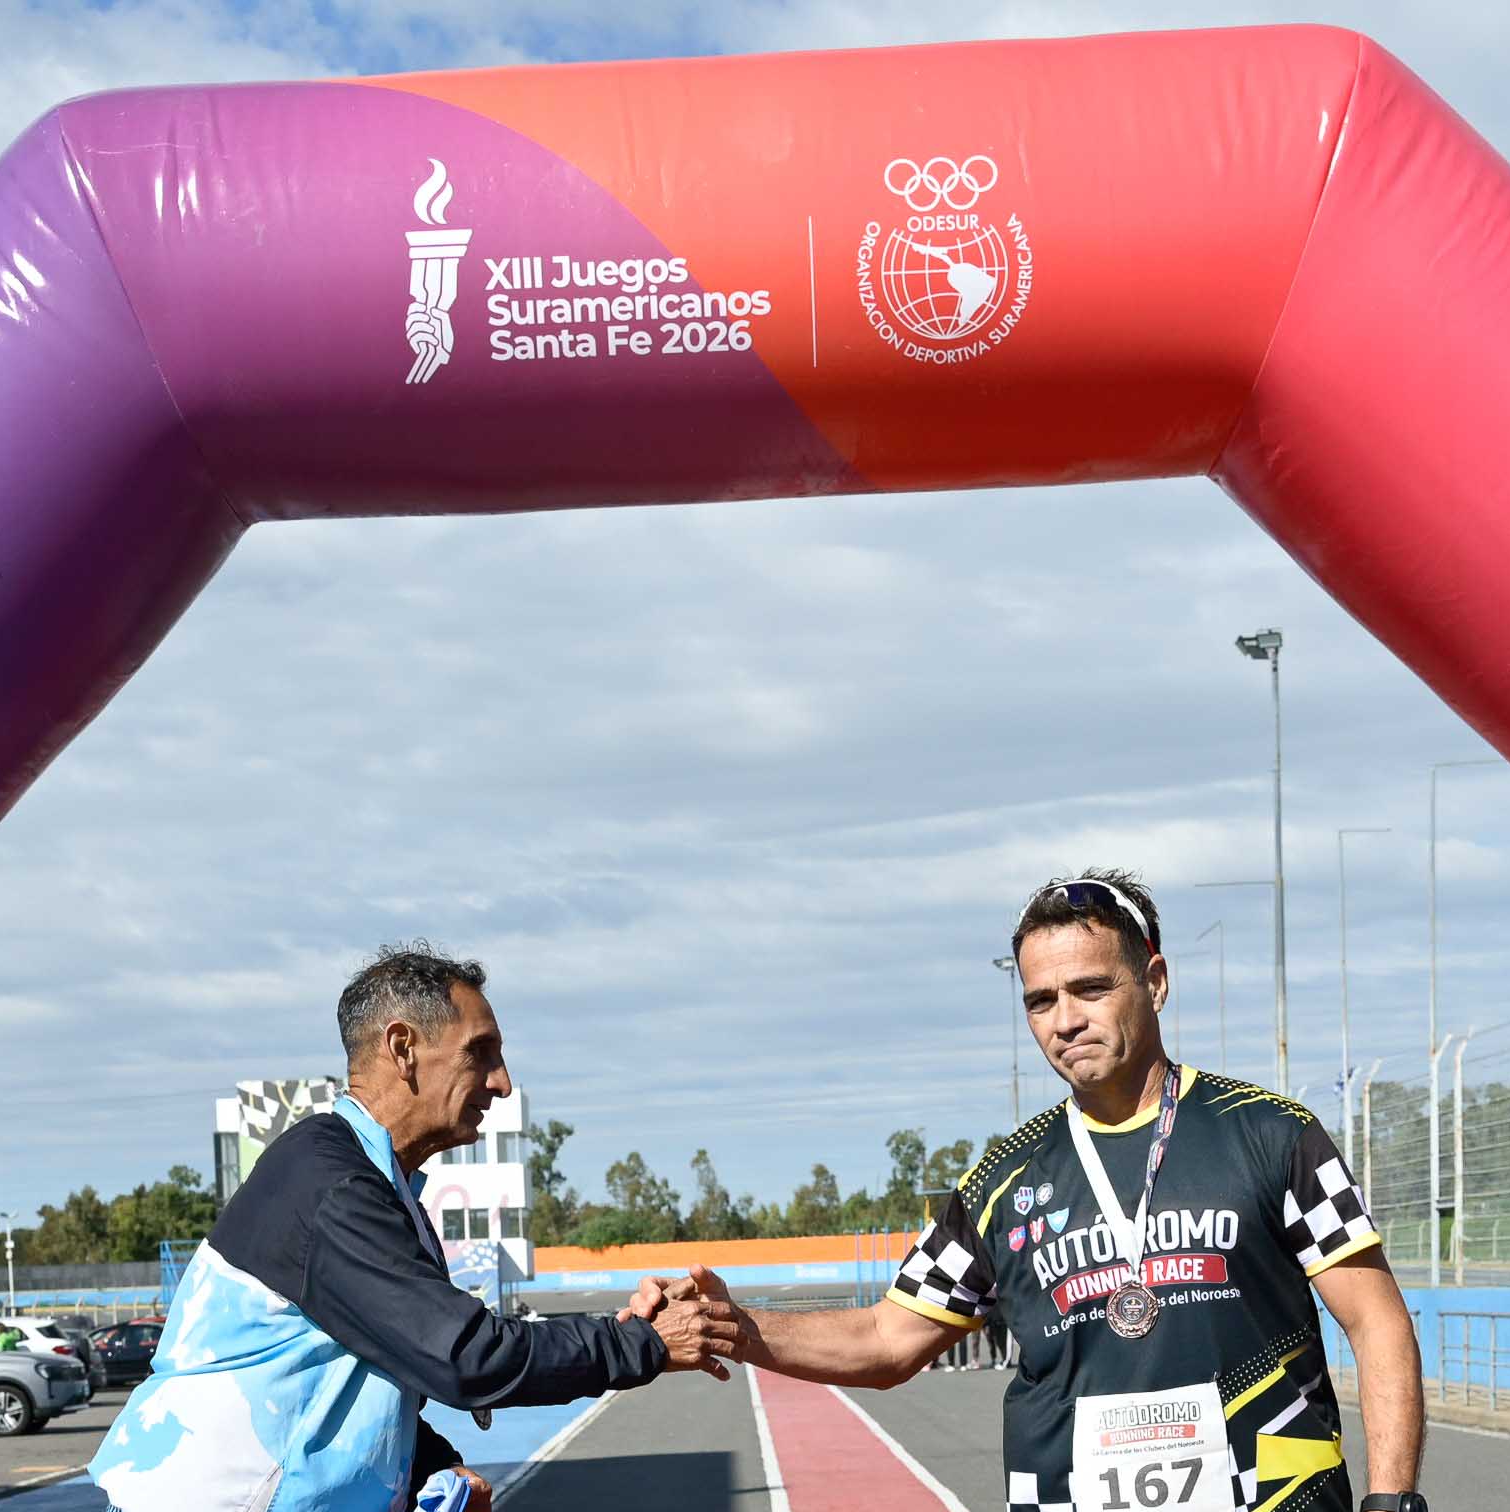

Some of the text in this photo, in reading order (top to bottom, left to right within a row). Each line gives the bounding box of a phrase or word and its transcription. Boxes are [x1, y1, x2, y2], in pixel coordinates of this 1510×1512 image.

[907, 215, 980, 232] ODESUR
[484, 254, 688, 293] XIII Juegos
[857, 213, 1033, 364] ORGANIZACION DEPORTIVA SURAMERICANA
[487, 289, 771, 328] Suramericanos
[489, 319, 752, 361] Santa Fe 2026
[1032, 1209, 1239, 1290] AUTÓROMO
[1152, 1258, 1204, 1282] RACE
[1044, 1325, 1059, 1337] La
[1089, 1307, 1105, 1320] de
[1169, 1291, 1188, 1306] del
[1158, 1426, 1185, 1438] RACE
[1099, 1457, 1203, 1511] 167
